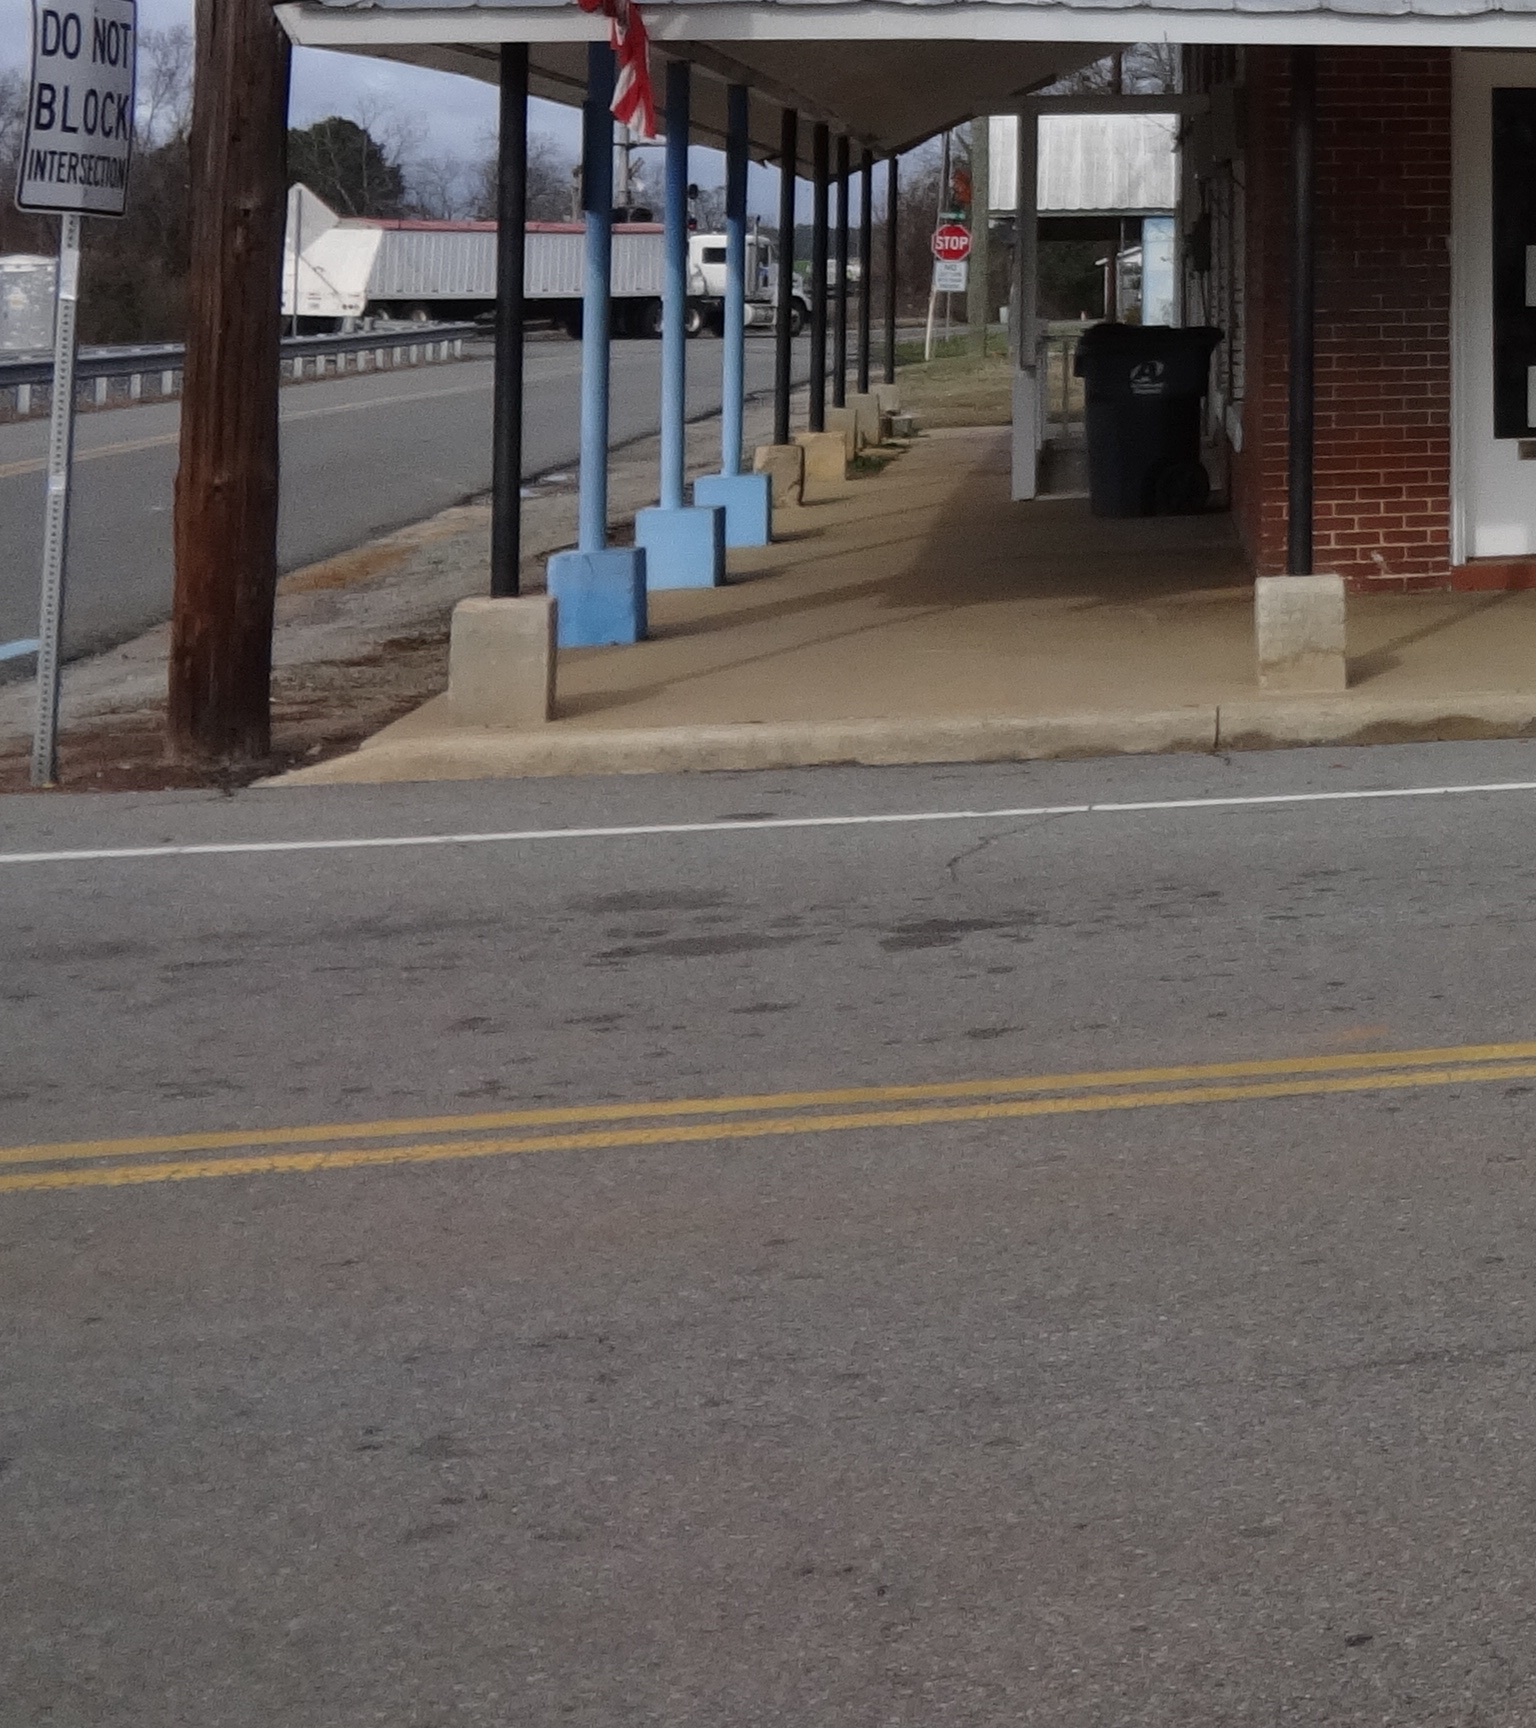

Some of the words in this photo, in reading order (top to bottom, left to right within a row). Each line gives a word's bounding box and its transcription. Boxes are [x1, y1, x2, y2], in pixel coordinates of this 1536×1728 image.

[41, 9, 81, 60] DO
[92, 16, 132, 69] NOT
[34, 82, 130, 141] BLOCK
[27, 148, 126, 189] INTERSECTION
[935, 236, 969, 250] STOP
